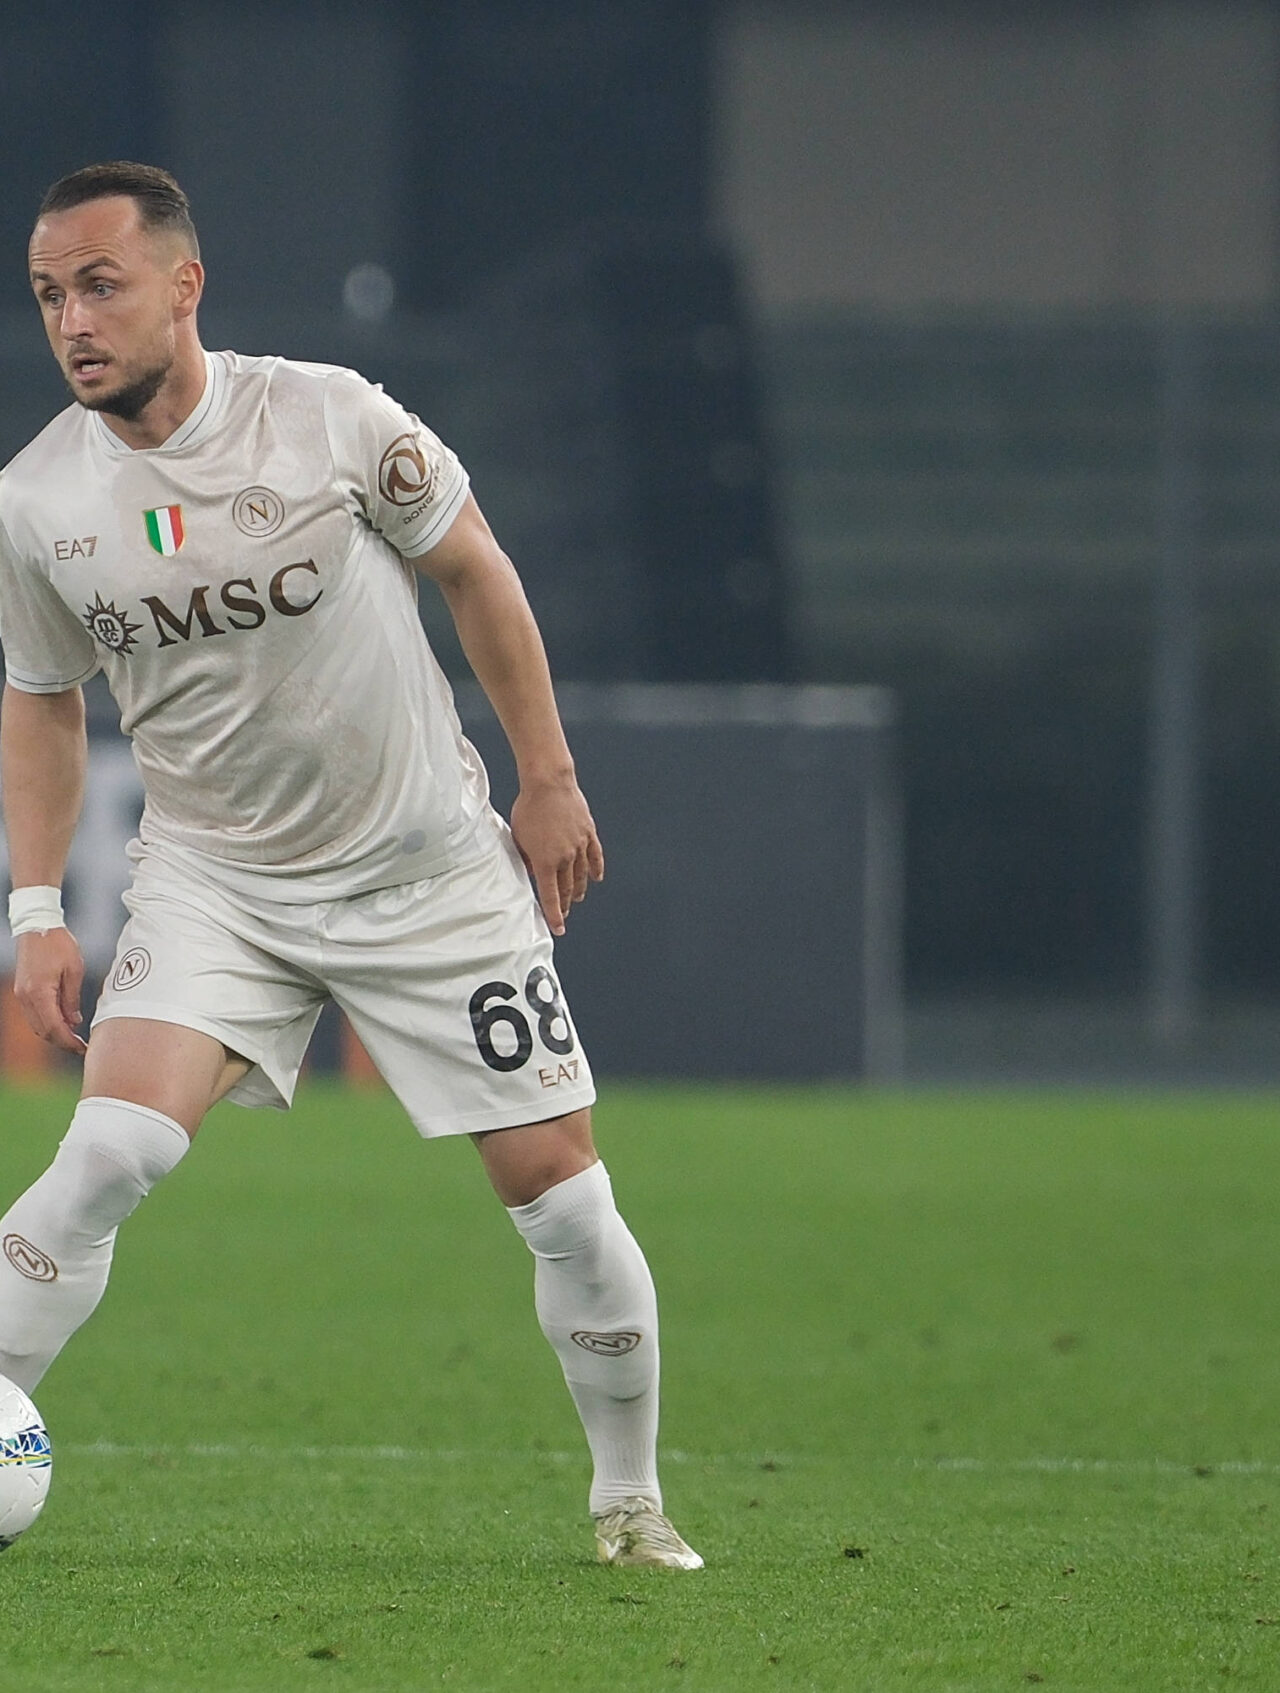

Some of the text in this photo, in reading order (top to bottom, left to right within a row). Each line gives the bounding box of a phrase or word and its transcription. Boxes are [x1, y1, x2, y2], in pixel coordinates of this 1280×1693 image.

[246, 500, 269, 525] N
[54, 536, 98, 561] EA7
[140, 558, 324, 649] MSC
[119, 958, 141, 981] N
[468, 965, 575, 1073] 68
[538, 1059, 579, 1089] EA7
